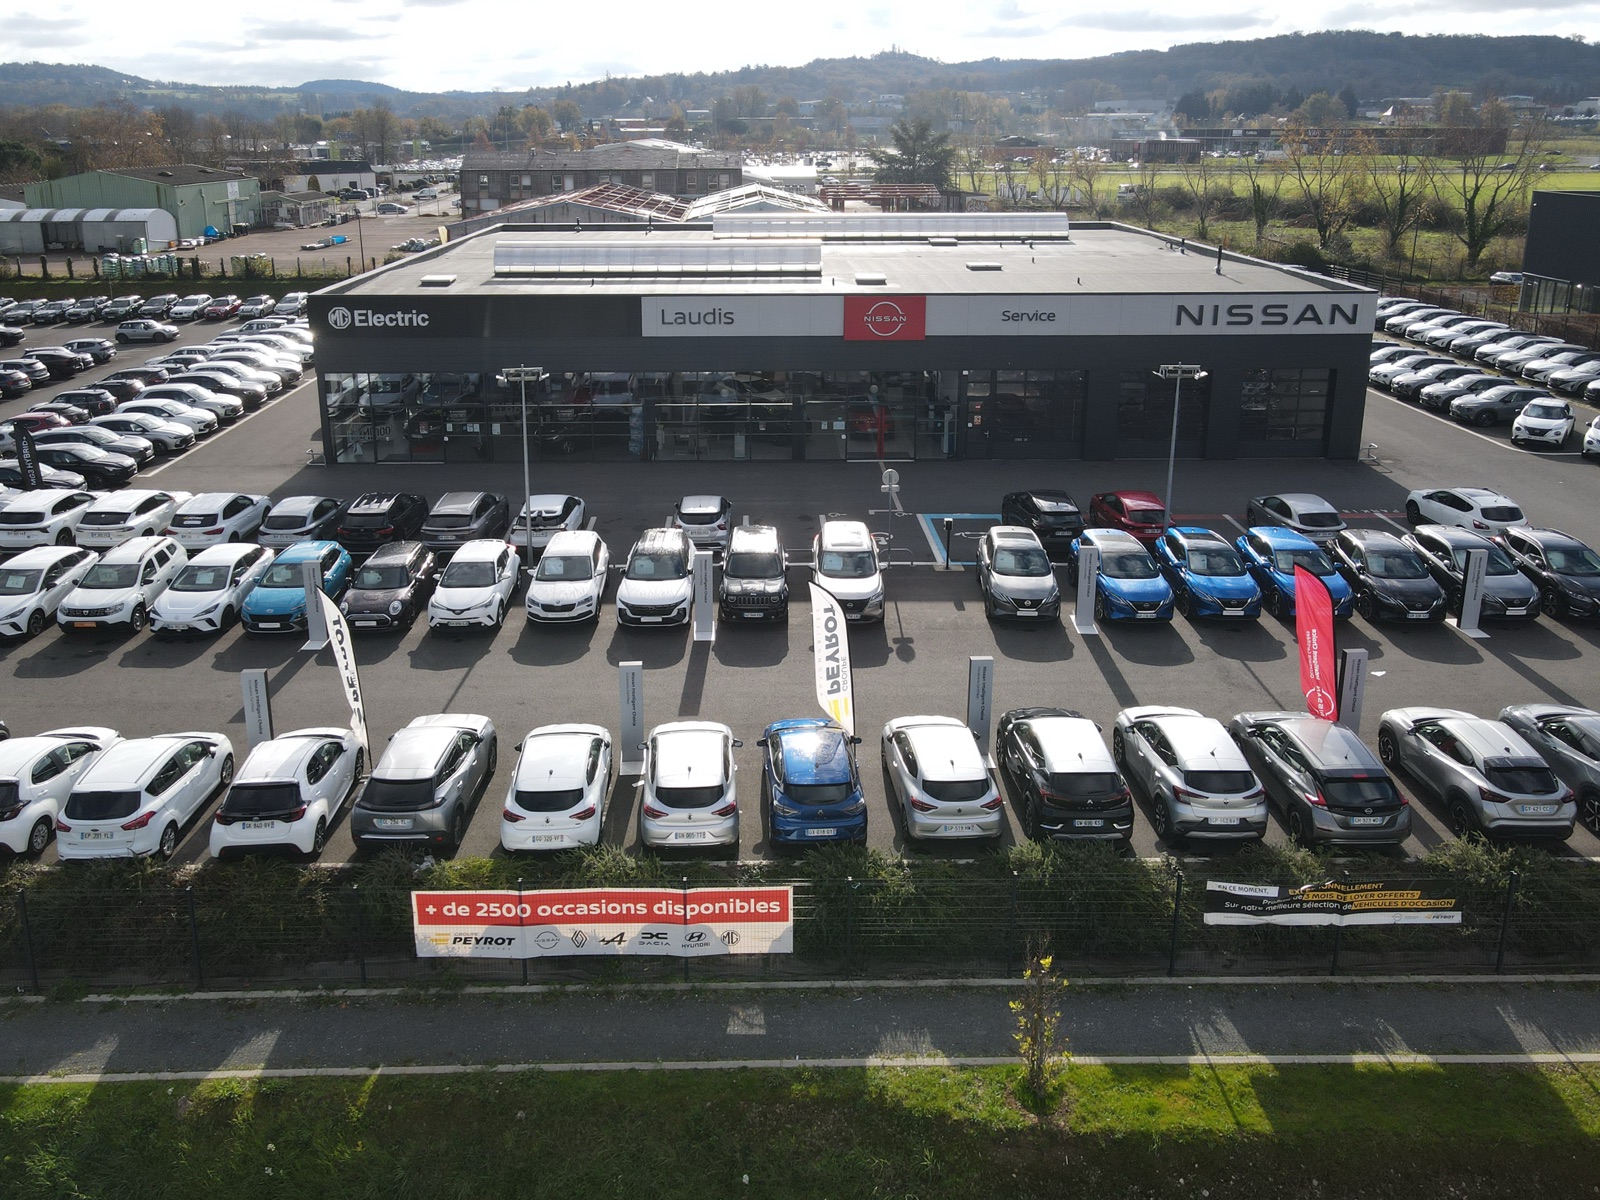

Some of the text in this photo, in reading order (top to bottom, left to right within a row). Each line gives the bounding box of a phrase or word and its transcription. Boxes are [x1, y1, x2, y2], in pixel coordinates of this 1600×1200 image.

[329, 308, 430, 328] MG Electric
[661, 307, 735, 325] Laudis
[1001, 309, 1056, 321] Service
[1175, 303, 1359, 326] NISSAN
[28, 469, 37, 486] MG3
[425, 898, 781, 919] + de 2500 occasions disponibles
[452, 936, 516, 946] PEYROT
[722, 930, 740, 945] MG
